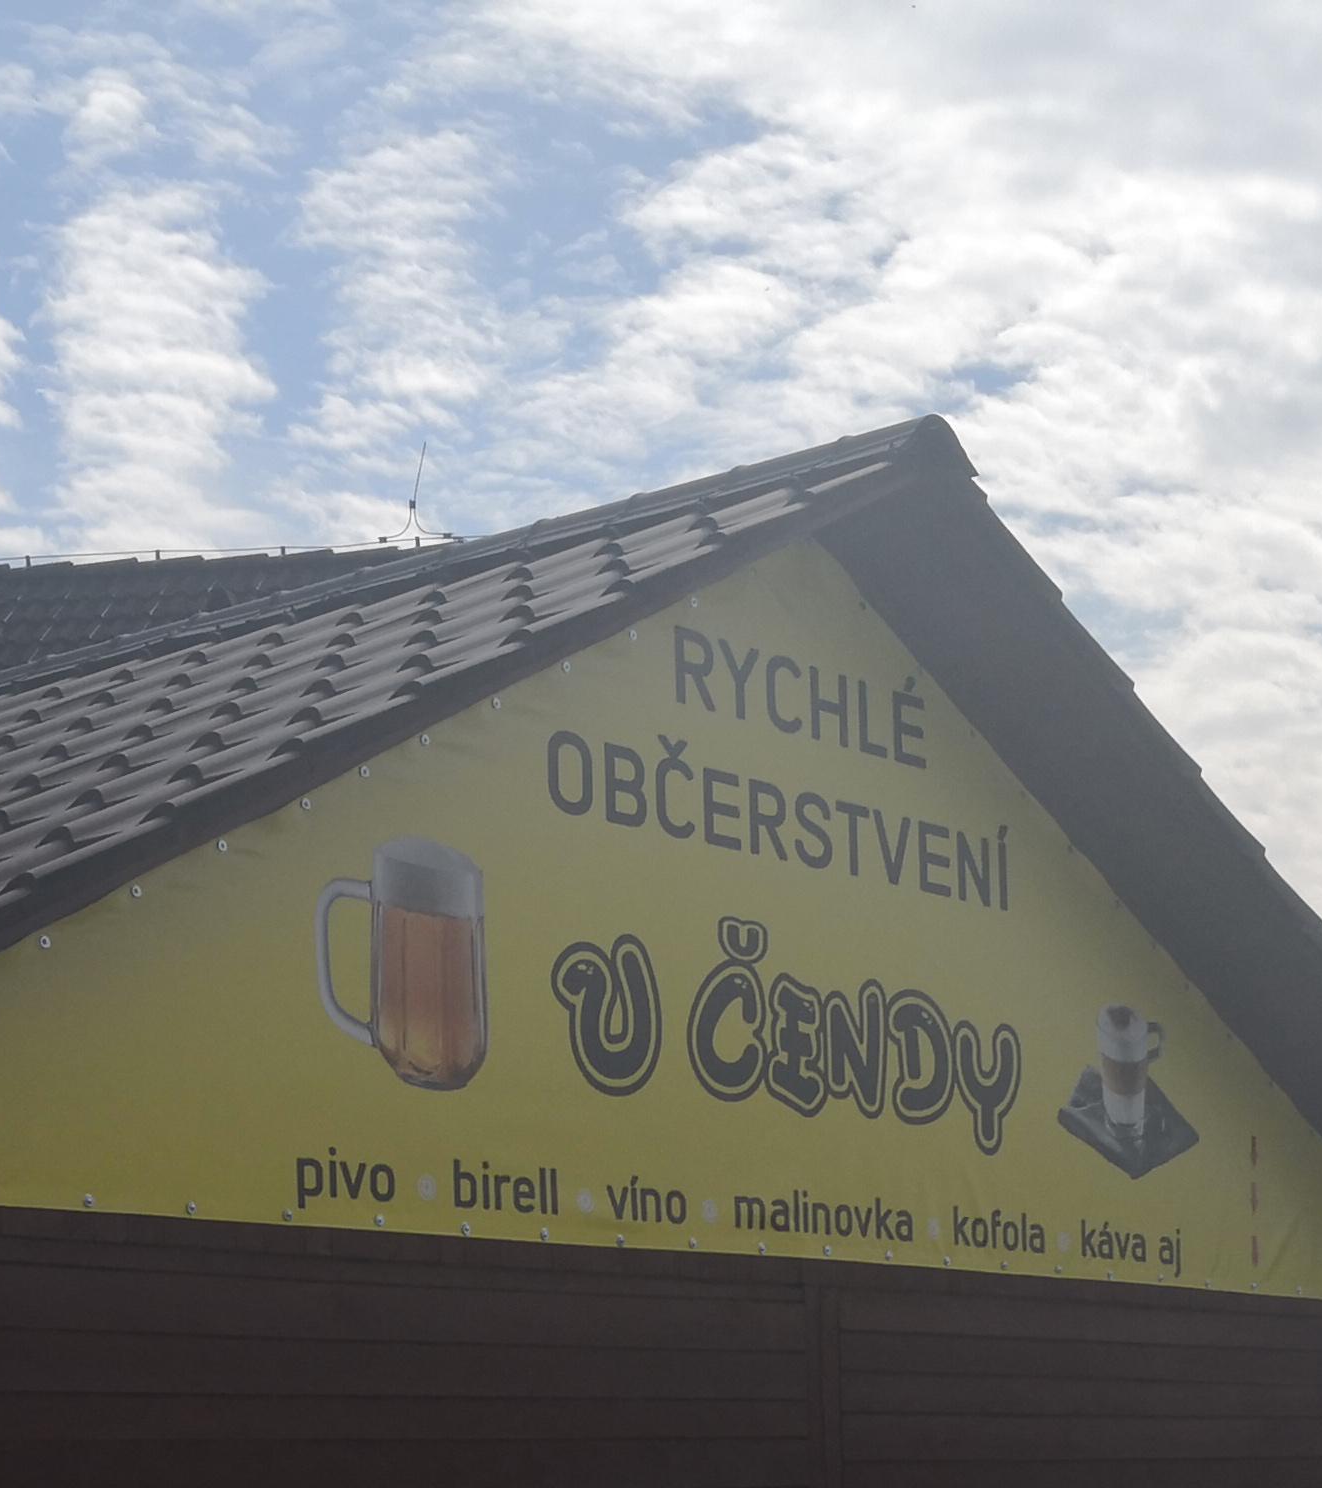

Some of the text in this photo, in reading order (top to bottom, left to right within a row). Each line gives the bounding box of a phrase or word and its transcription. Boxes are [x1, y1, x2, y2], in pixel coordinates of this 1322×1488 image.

[674, 626, 927, 769] RYCHLÉ
[547, 730, 1008, 911] OBČERSTVENÍ
[551, 916, 1021, 1156] U ČENDY
[296, 1147, 1181, 1278] pivo birell víno malinovka kofola káva aj
